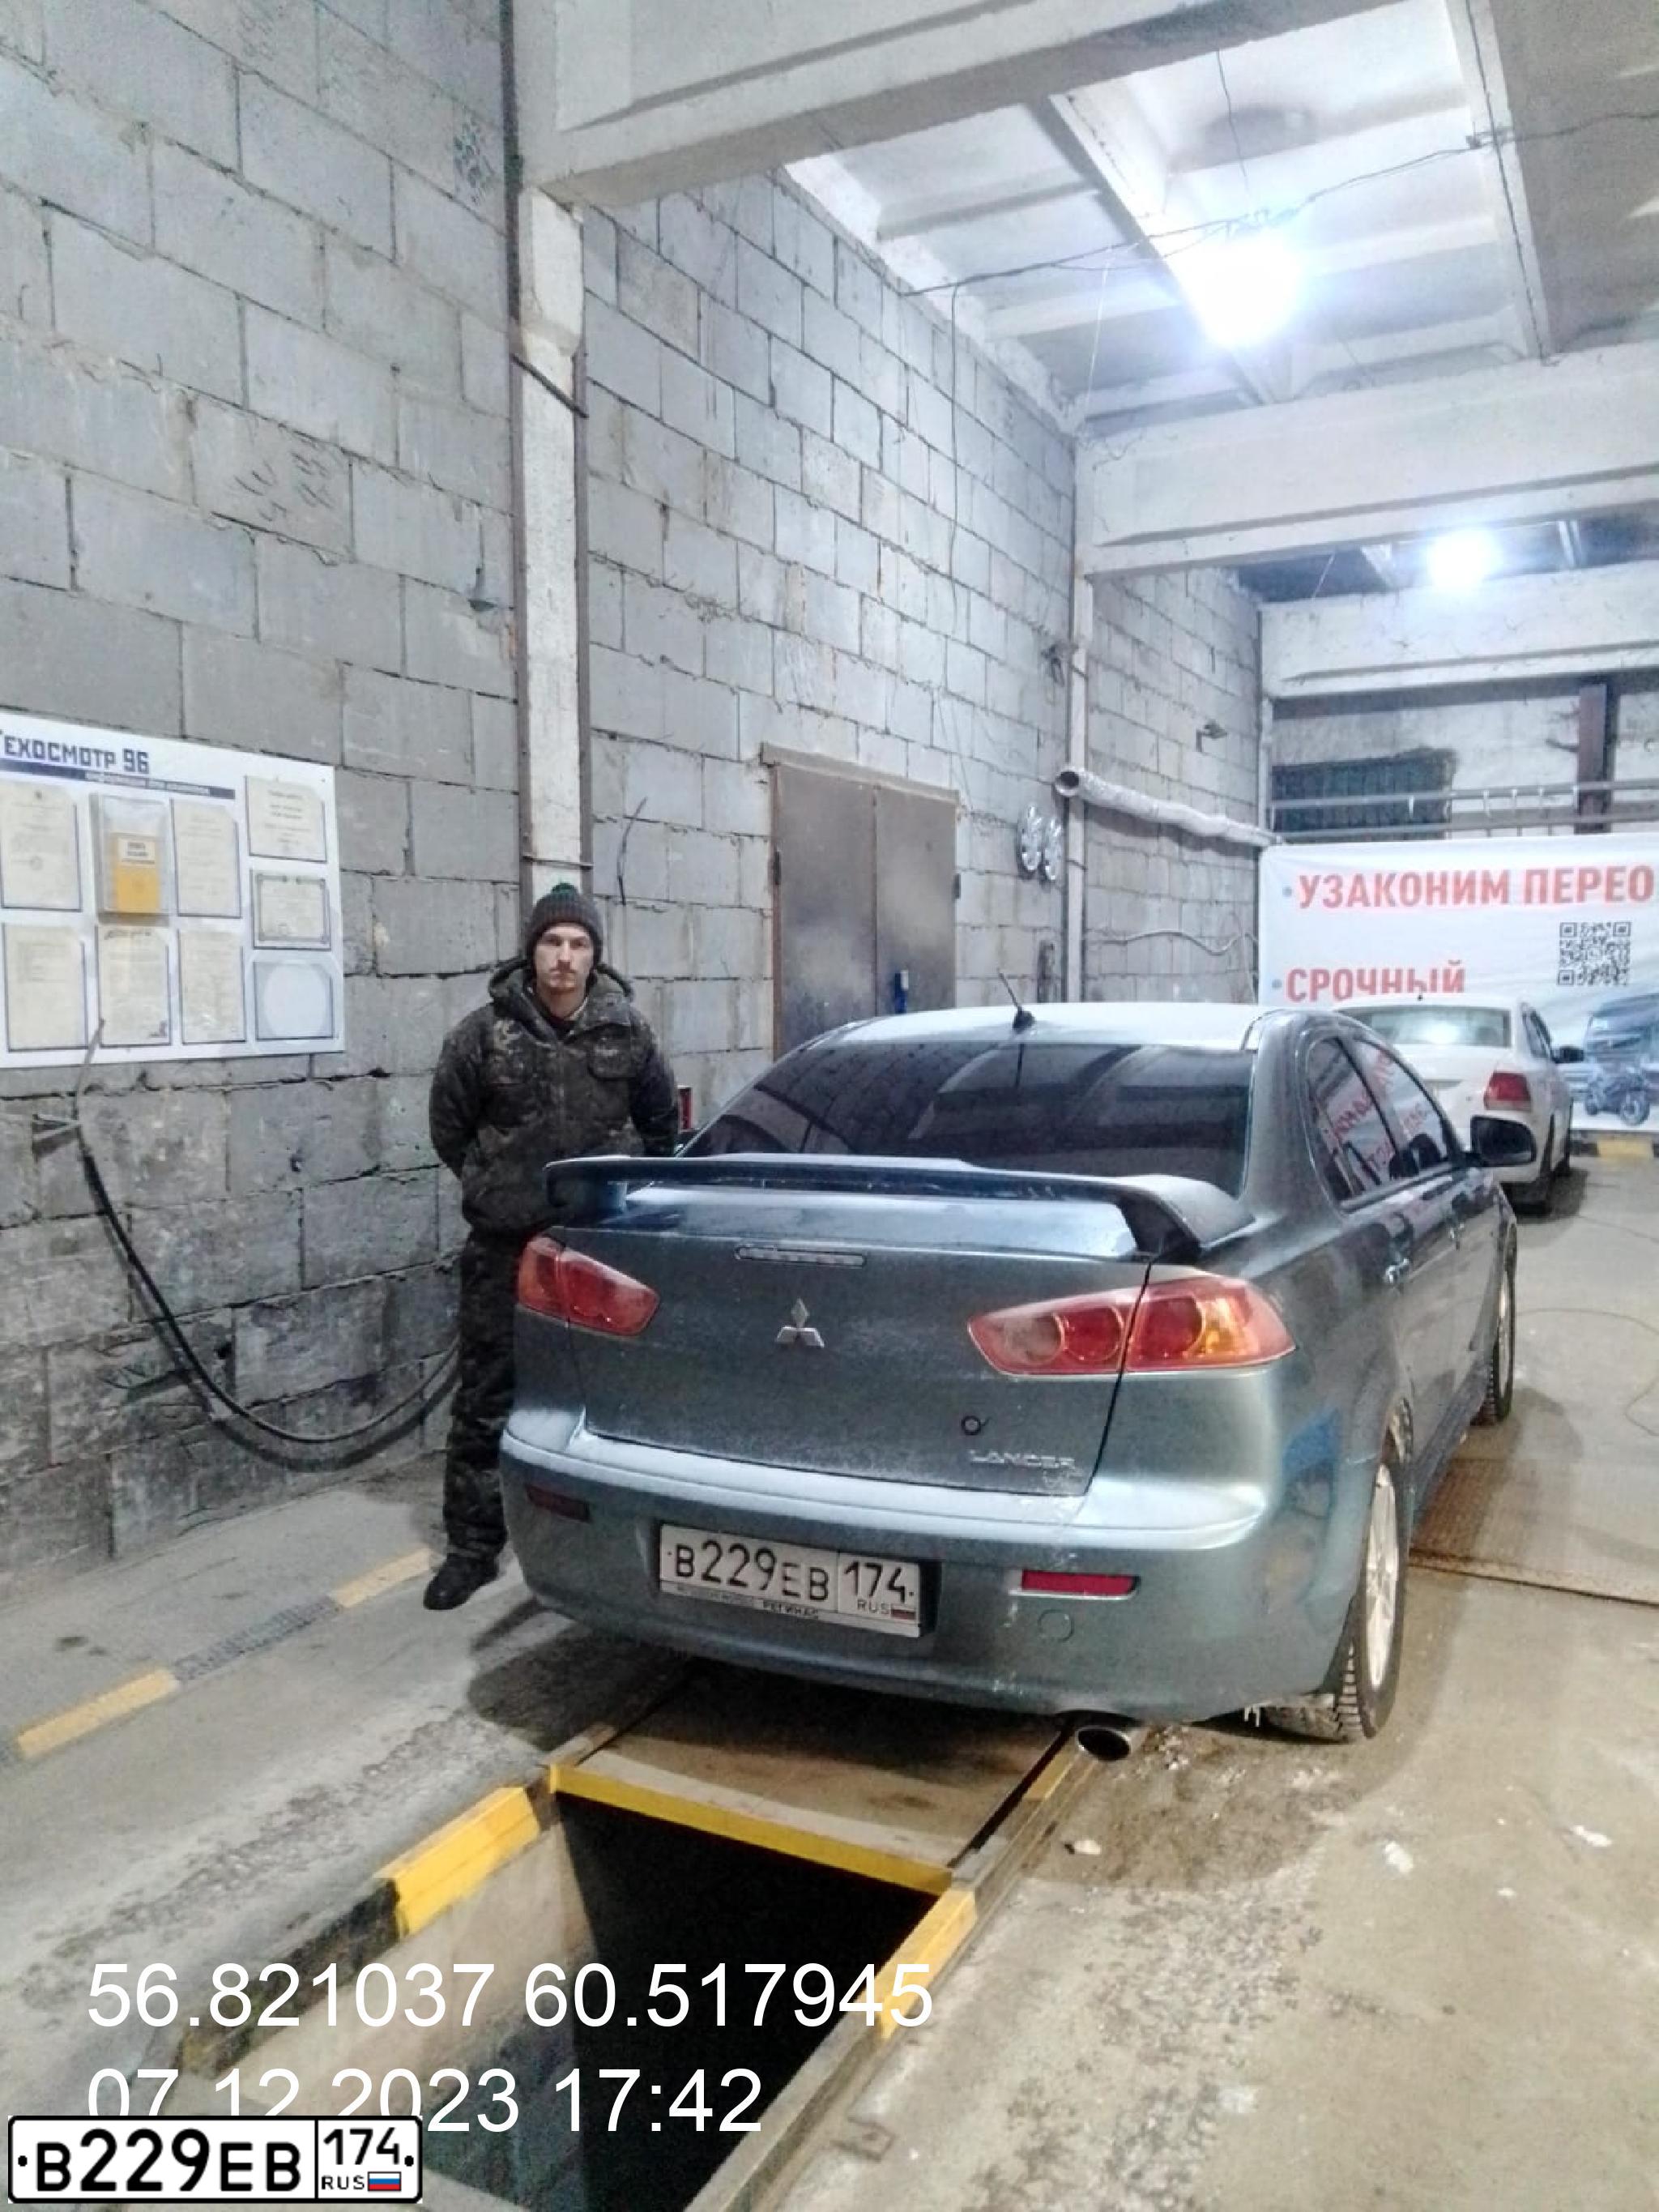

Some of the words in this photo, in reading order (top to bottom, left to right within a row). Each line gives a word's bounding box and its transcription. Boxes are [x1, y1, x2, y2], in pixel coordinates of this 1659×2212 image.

[0, 732, 116, 768] ЕХОСМОТР
[123, 747, 149, 774] 96
[1299, 869, 1509, 910] УЗАКОНИМ
[1523, 865, 1654, 905] ПЕРЕО
[1286, 959, 1465, 1002] СРОЧНЫЙ
[970, 1449, 1076, 1471] LANCER
[844, 1561, 907, 1603] 174
[856, 1598, 890, 1615] RUS
